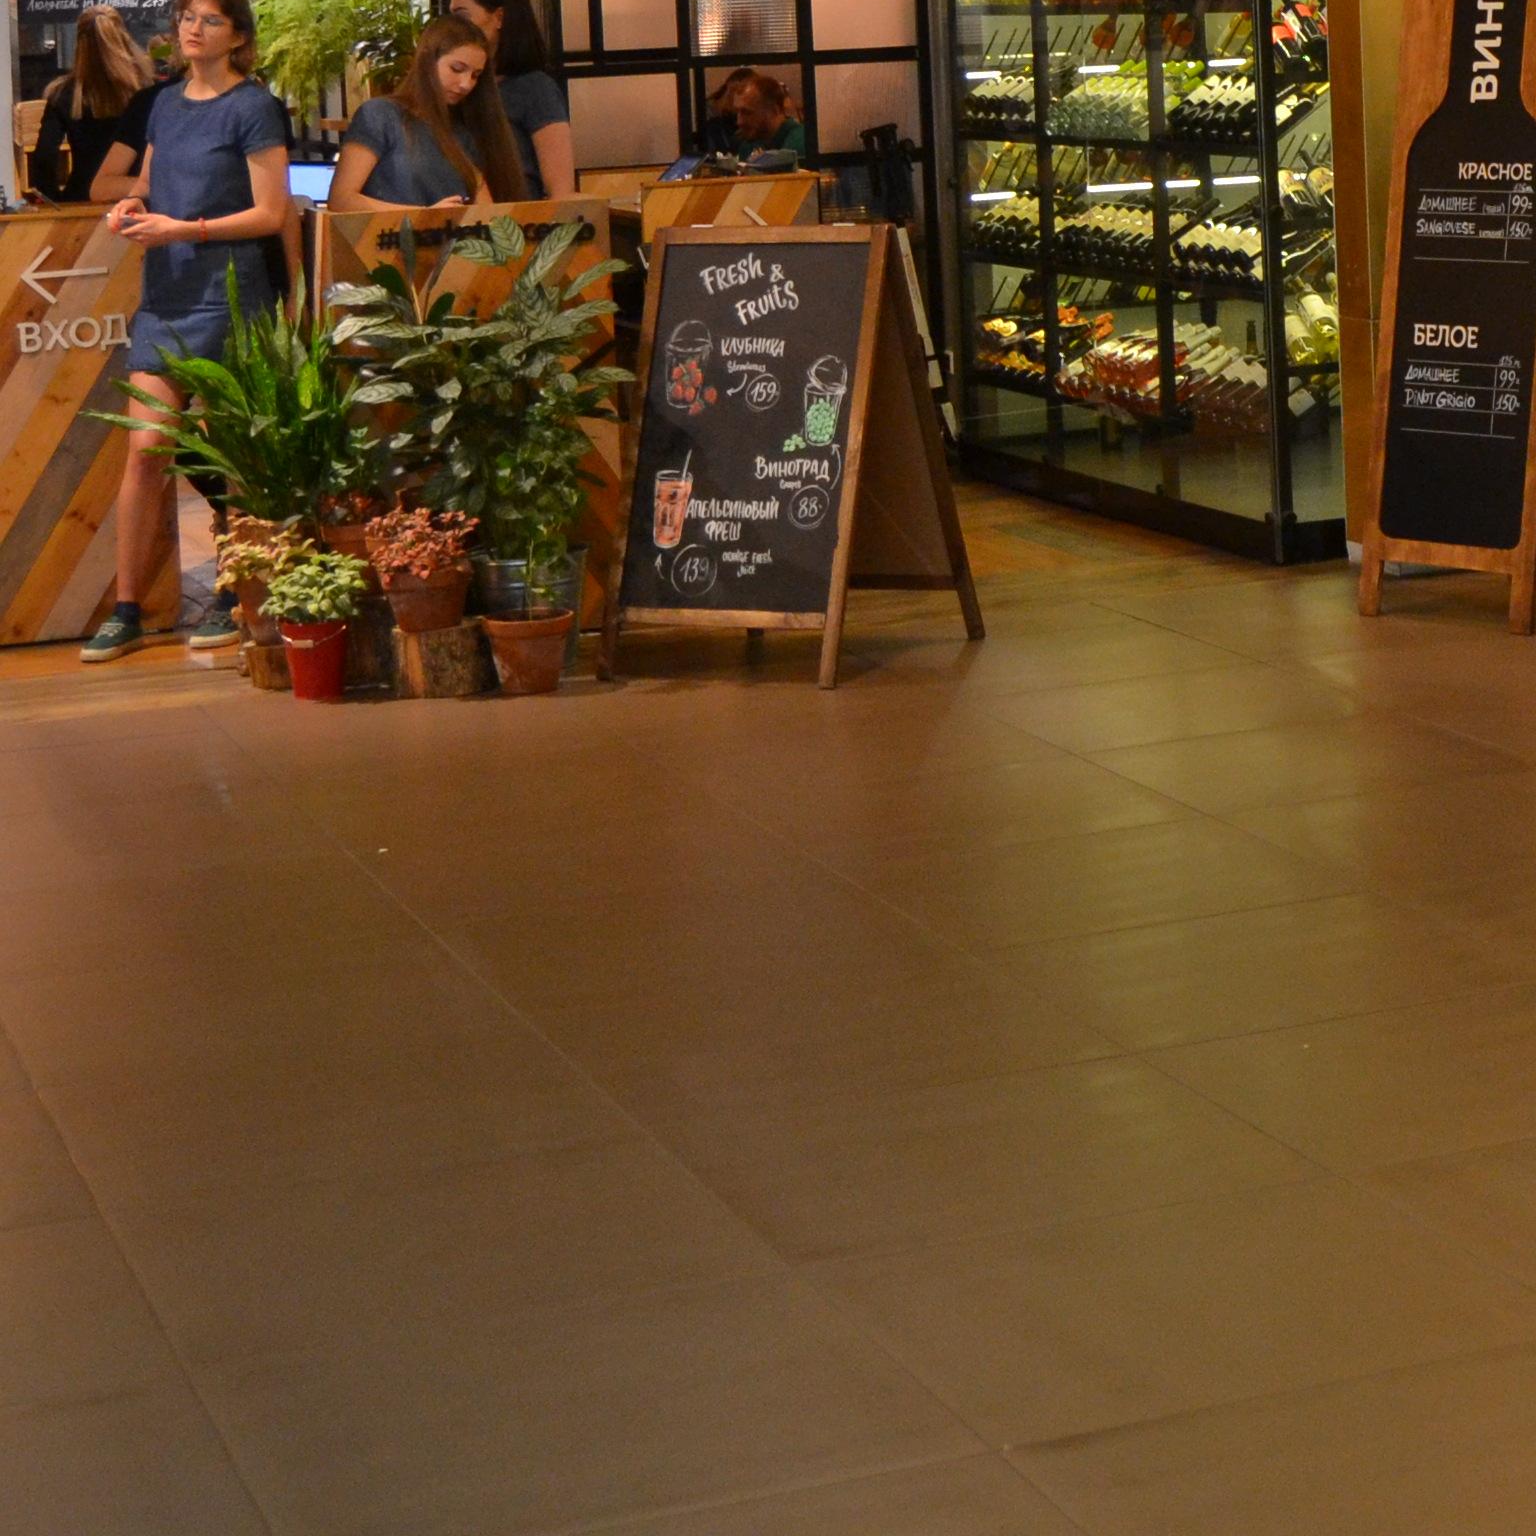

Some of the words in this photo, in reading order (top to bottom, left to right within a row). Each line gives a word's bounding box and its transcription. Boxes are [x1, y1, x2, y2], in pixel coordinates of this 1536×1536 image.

[1458, 162, 1533, 181] КРАСНОЕ
[17, 314, 131, 353] ВХОД
[1414, 324, 1479, 348] БЕЛОЕ
[720, 337, 786, 357] КЛУБНИКА
[685, 495, 779, 519] АПЕЛЬСИНОВЫЙ
[704, 520, 741, 541] ФРЕШ
